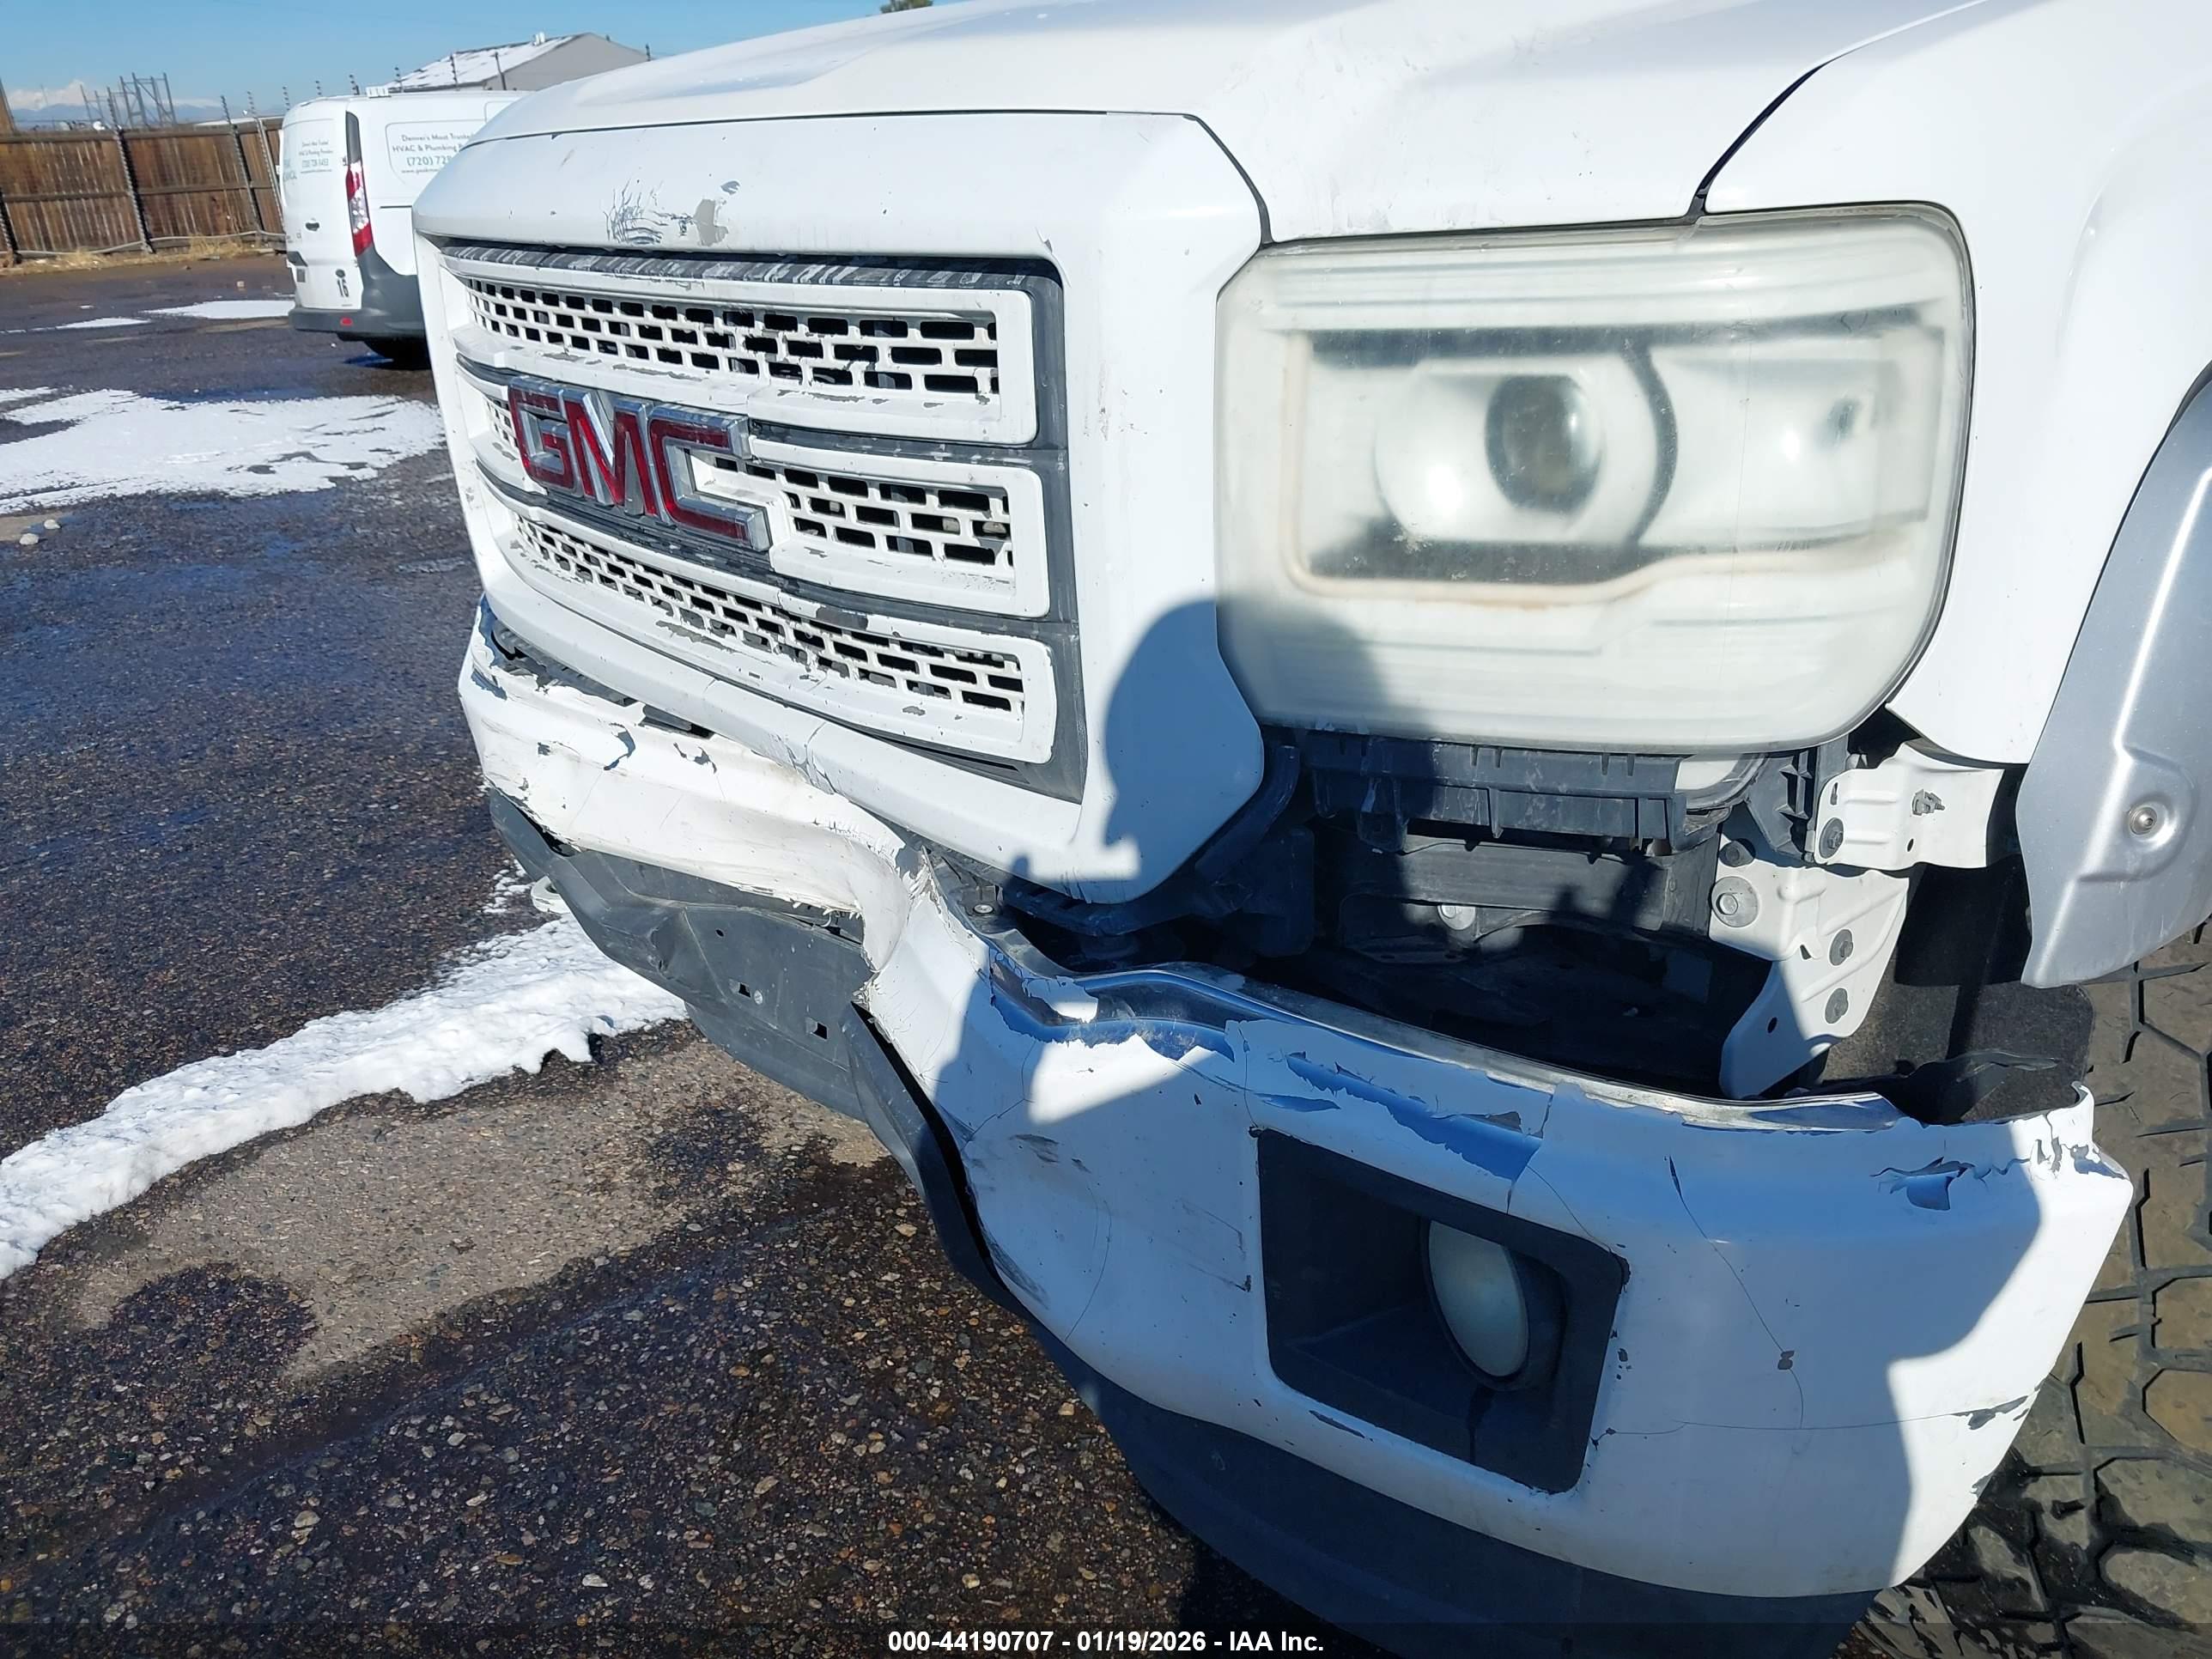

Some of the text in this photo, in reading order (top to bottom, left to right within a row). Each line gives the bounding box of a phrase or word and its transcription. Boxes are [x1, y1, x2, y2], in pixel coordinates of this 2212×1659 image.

[424, 143, 457, 153] Plumbing
[406, 155, 434, 167] (720)
[337, 277, 349, 298] 16
[508, 375, 773, 551] GMC
